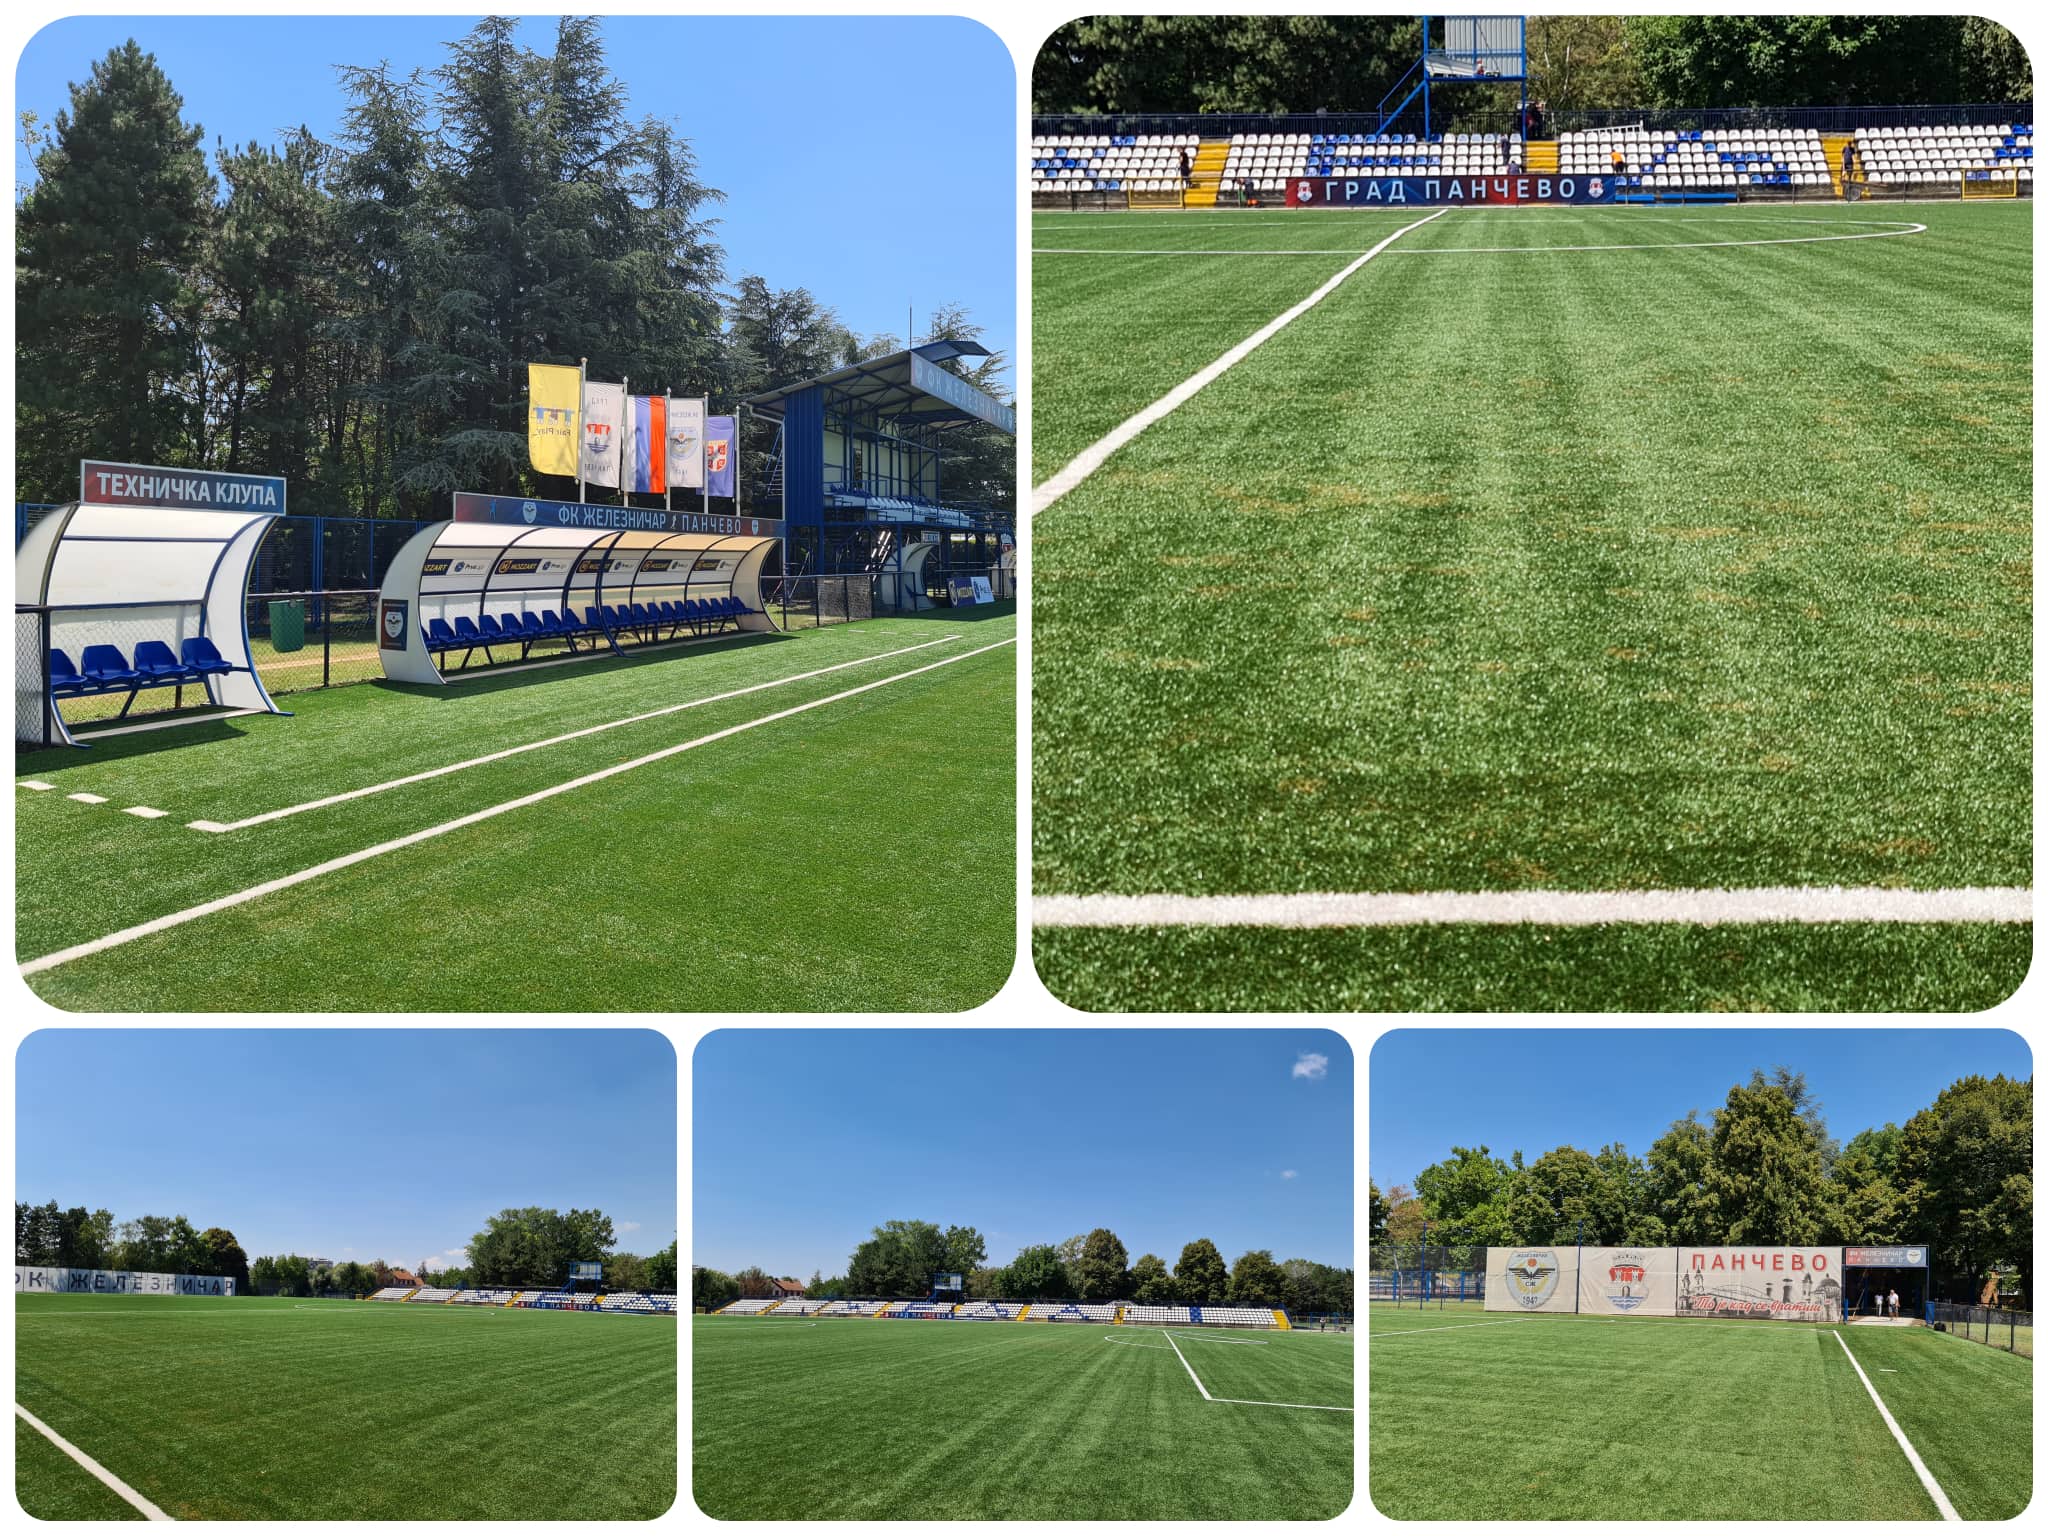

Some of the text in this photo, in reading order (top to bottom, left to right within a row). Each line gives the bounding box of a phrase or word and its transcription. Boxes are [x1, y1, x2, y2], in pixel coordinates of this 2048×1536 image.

[1325, 178, 1576, 202] ГРАД ПАНЧЕВО
[97, 472, 277, 506] ТЕХНИЧКА КЛУПА
[558, 505, 741, 534] ФК ЖЕЛЕЗНИЧАР ПАНЧЕВО
[1692, 1254, 1827, 1271] ПАНЧЕВО
[70, 1274, 234, 1293] ЖЕЛЕЗНИЧАР
